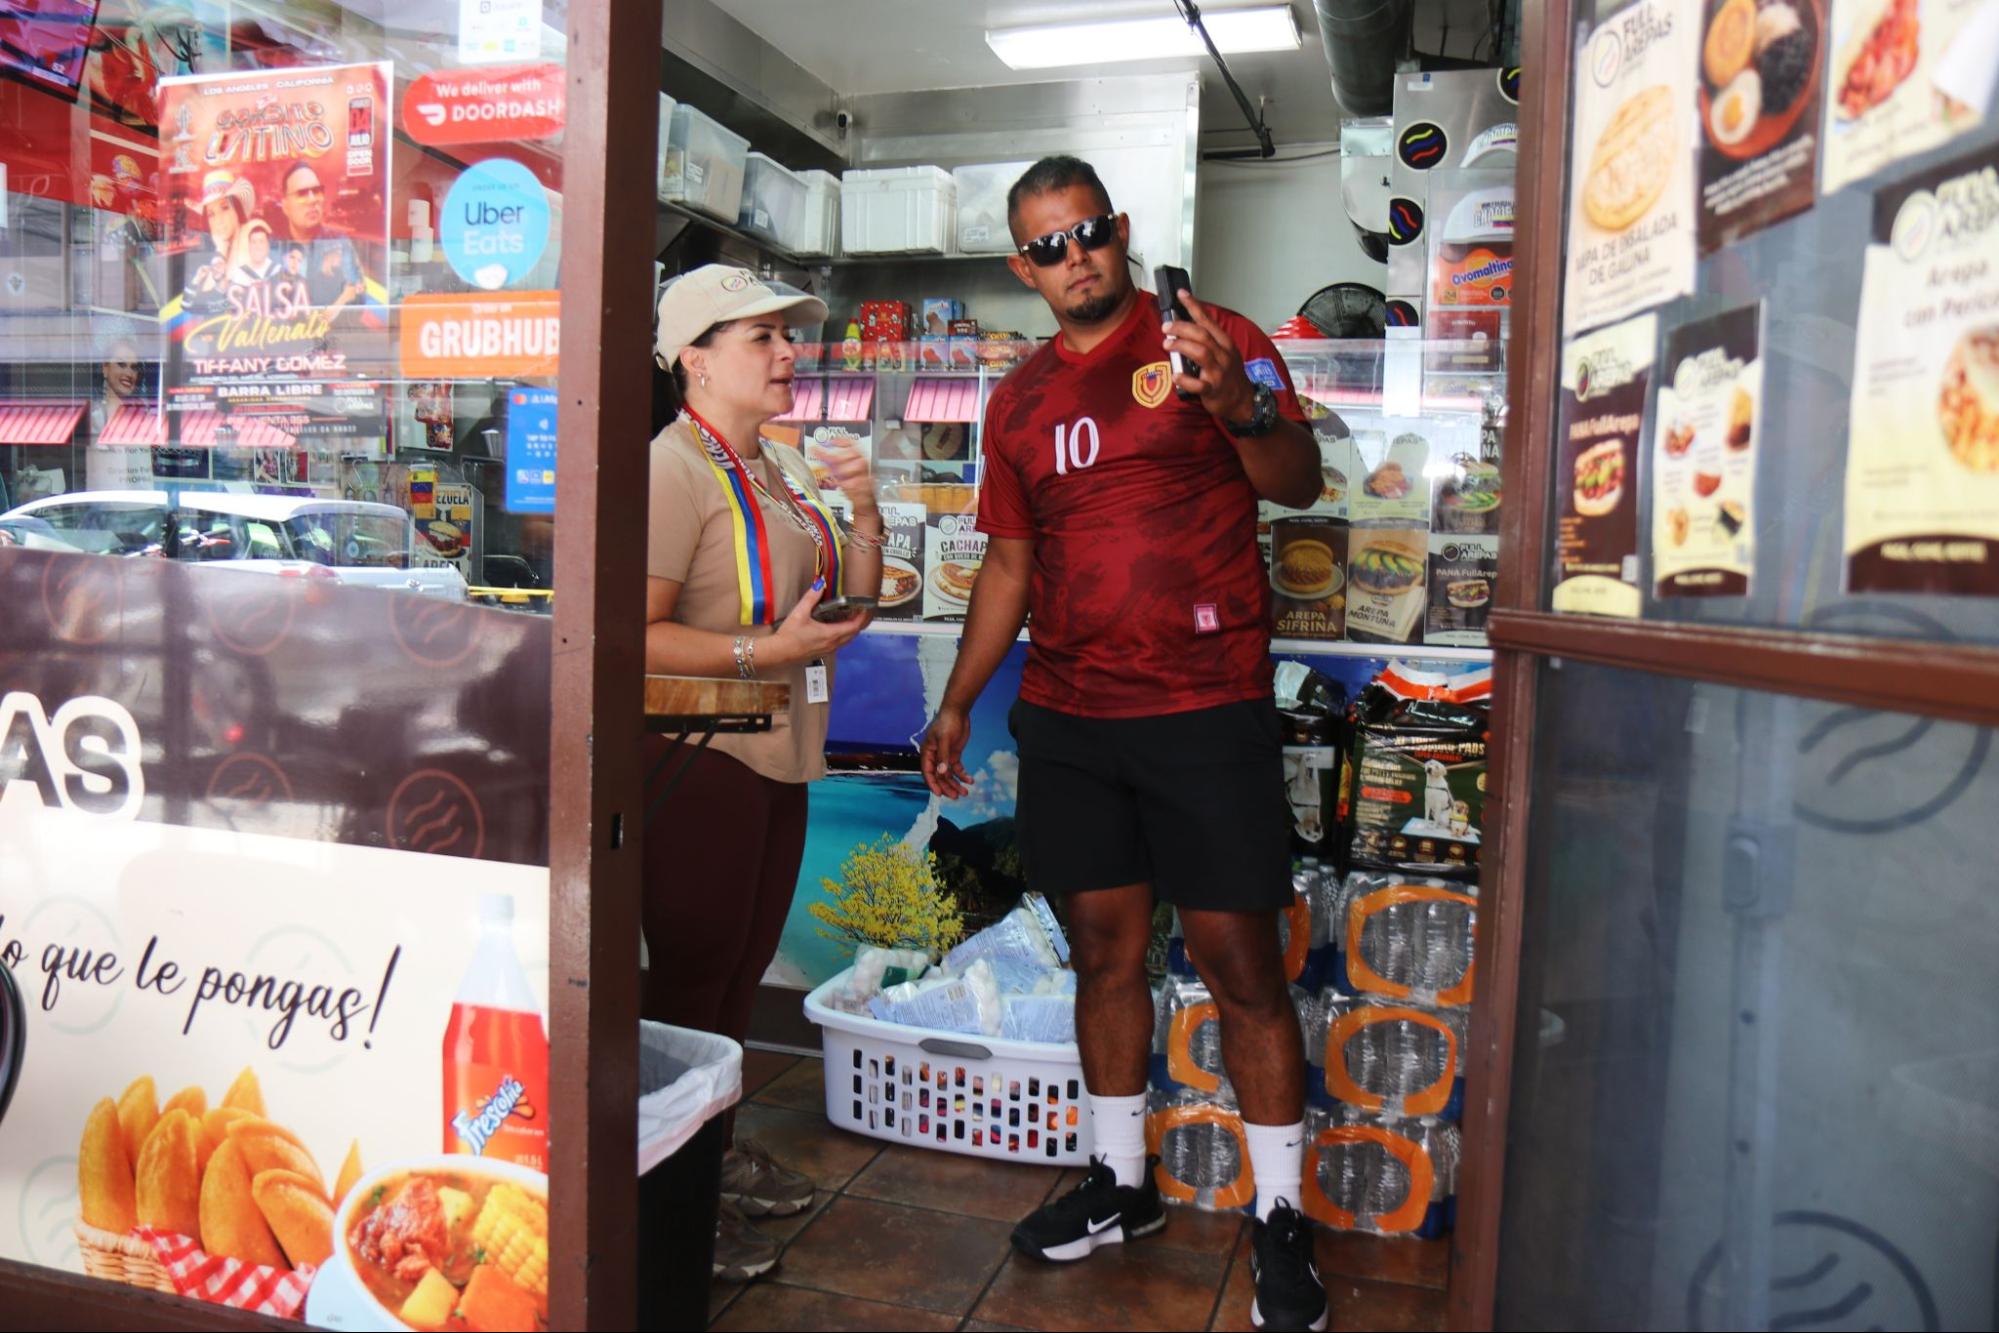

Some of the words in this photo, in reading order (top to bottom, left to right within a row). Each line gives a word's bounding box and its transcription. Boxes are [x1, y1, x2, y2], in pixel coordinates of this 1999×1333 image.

[436, 84, 459, 98] We
[461, 80, 508, 97] deliver
[511, 78, 542, 93] with
[452, 98, 561, 122] DOORDASH
[204, 121, 333, 166] LATINO
[464, 201, 525, 226] Uber
[463, 229, 524, 256] Eats
[226, 279, 311, 322] SALSA
[184, 310, 332, 353] Vallenato
[419, 317, 560, 359] GRUBHUB
[193, 357, 271, 374] TIFFANY
[276, 354, 347, 372] GOMEZ
[217, 386, 270, 398] BARRA
[276, 384, 322, 396] LIBRE
[1054, 416, 1099, 475] 10
[1286, 610, 1326, 620] AREPA
[1348, 609, 1396, 628] MONTUNA
[1358, 604, 1389, 618] AREPA
[1276, 620, 1337, 632] SIFRINA
[0, 700, 139, 818] AS
[41, 943, 124, 1011] que
[136, 934, 187, 991] le
[182, 944, 402, 1051] pongas!
